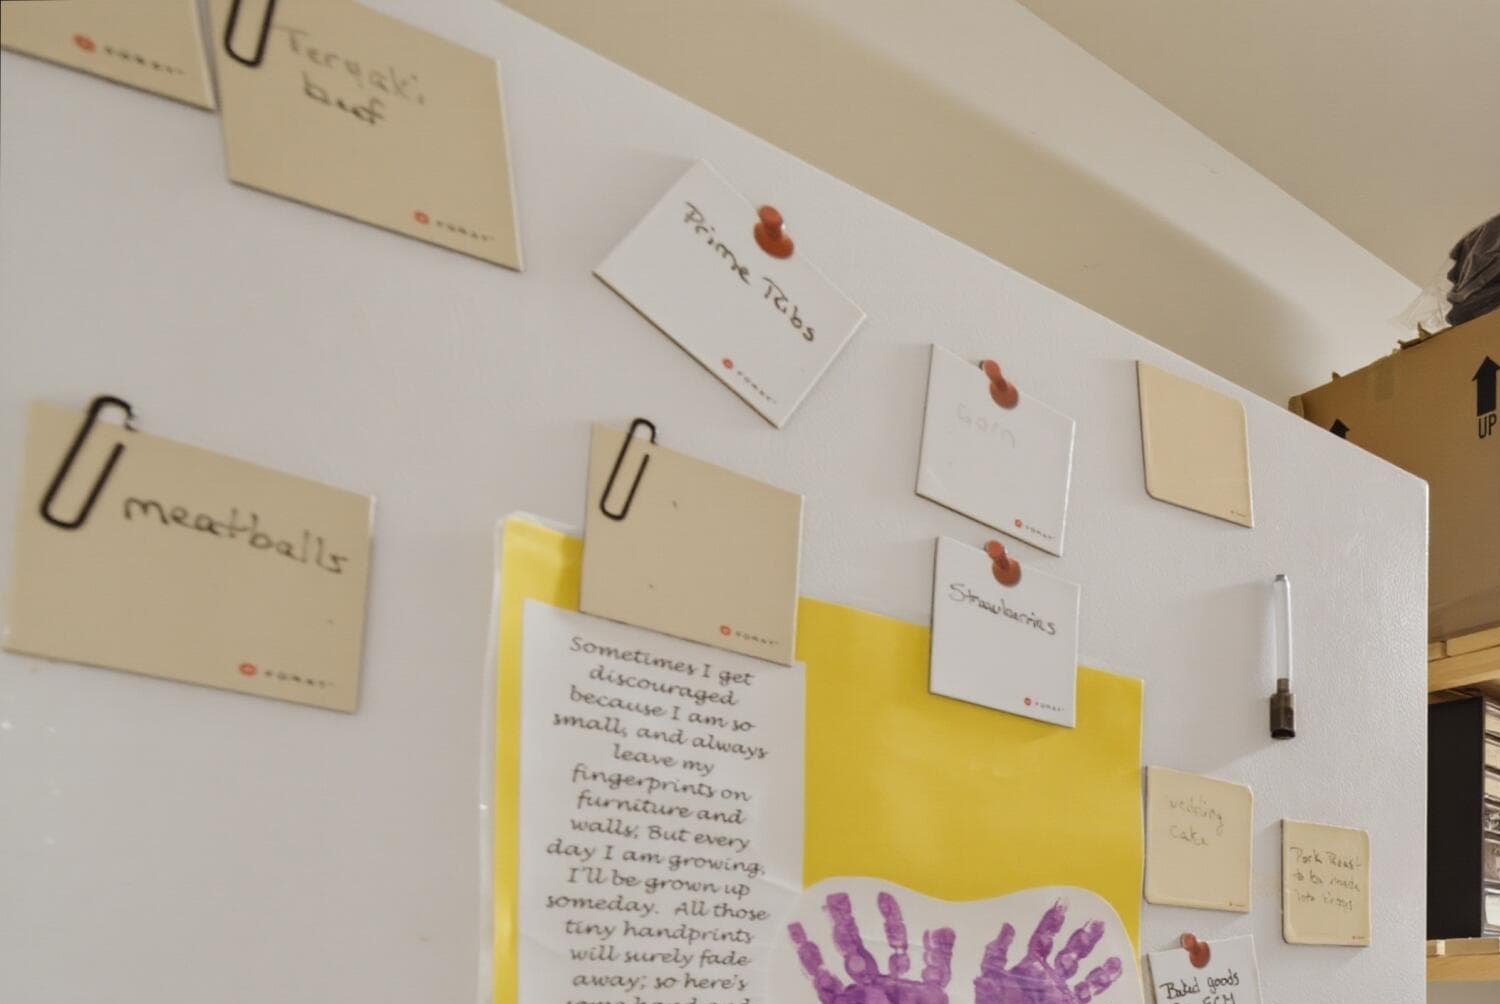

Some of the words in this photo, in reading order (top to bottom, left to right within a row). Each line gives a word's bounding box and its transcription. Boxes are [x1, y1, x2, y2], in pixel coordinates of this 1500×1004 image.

[683, 201, 751, 287] Prime
[1477, 414, 1498, 439] UP
[123, 496, 348, 575] meatballs
[570, 636, 698, 676] Sometimes
[702, 664, 711, 678] I
[718, 669, 755, 686] get
[589, 665, 738, 707] discouraged
[570, 685, 667, 717] because
[671, 706, 680, 721] I
[688, 712, 727, 728] am
[731, 720, 755, 732] so
[636, 727, 687, 745] and
[691, 733, 769, 760] always
[612, 744, 678, 767] leave
[682, 759, 715, 777] my
[571, 763, 715, 798] fingerprints
[720, 788, 752, 802] on
[576, 789, 693, 818] furniture
[696, 807, 746, 824] and
[545, 838, 597, 861] day
[603, 845, 613, 860] I
[622, 851, 664, 864] am
[648, 825, 692, 843] But
[694, 834, 750, 853] every
[567, 867, 607, 884] I'll
[612, 869, 641, 887] be
[644, 877, 720, 894] grown
[723, 884, 751, 901] up
[674, 901, 708, 917] All
[712, 903, 770, 921] those
[565, 919, 616, 938] tiny
[622, 920, 754, 945] handprints
[570, 945, 618, 962] will
[624, 948, 694, 968] surely
[698, 949, 751, 968] fade
[653, 976, 678, 990] so
[684, 972, 748, 991] here's
